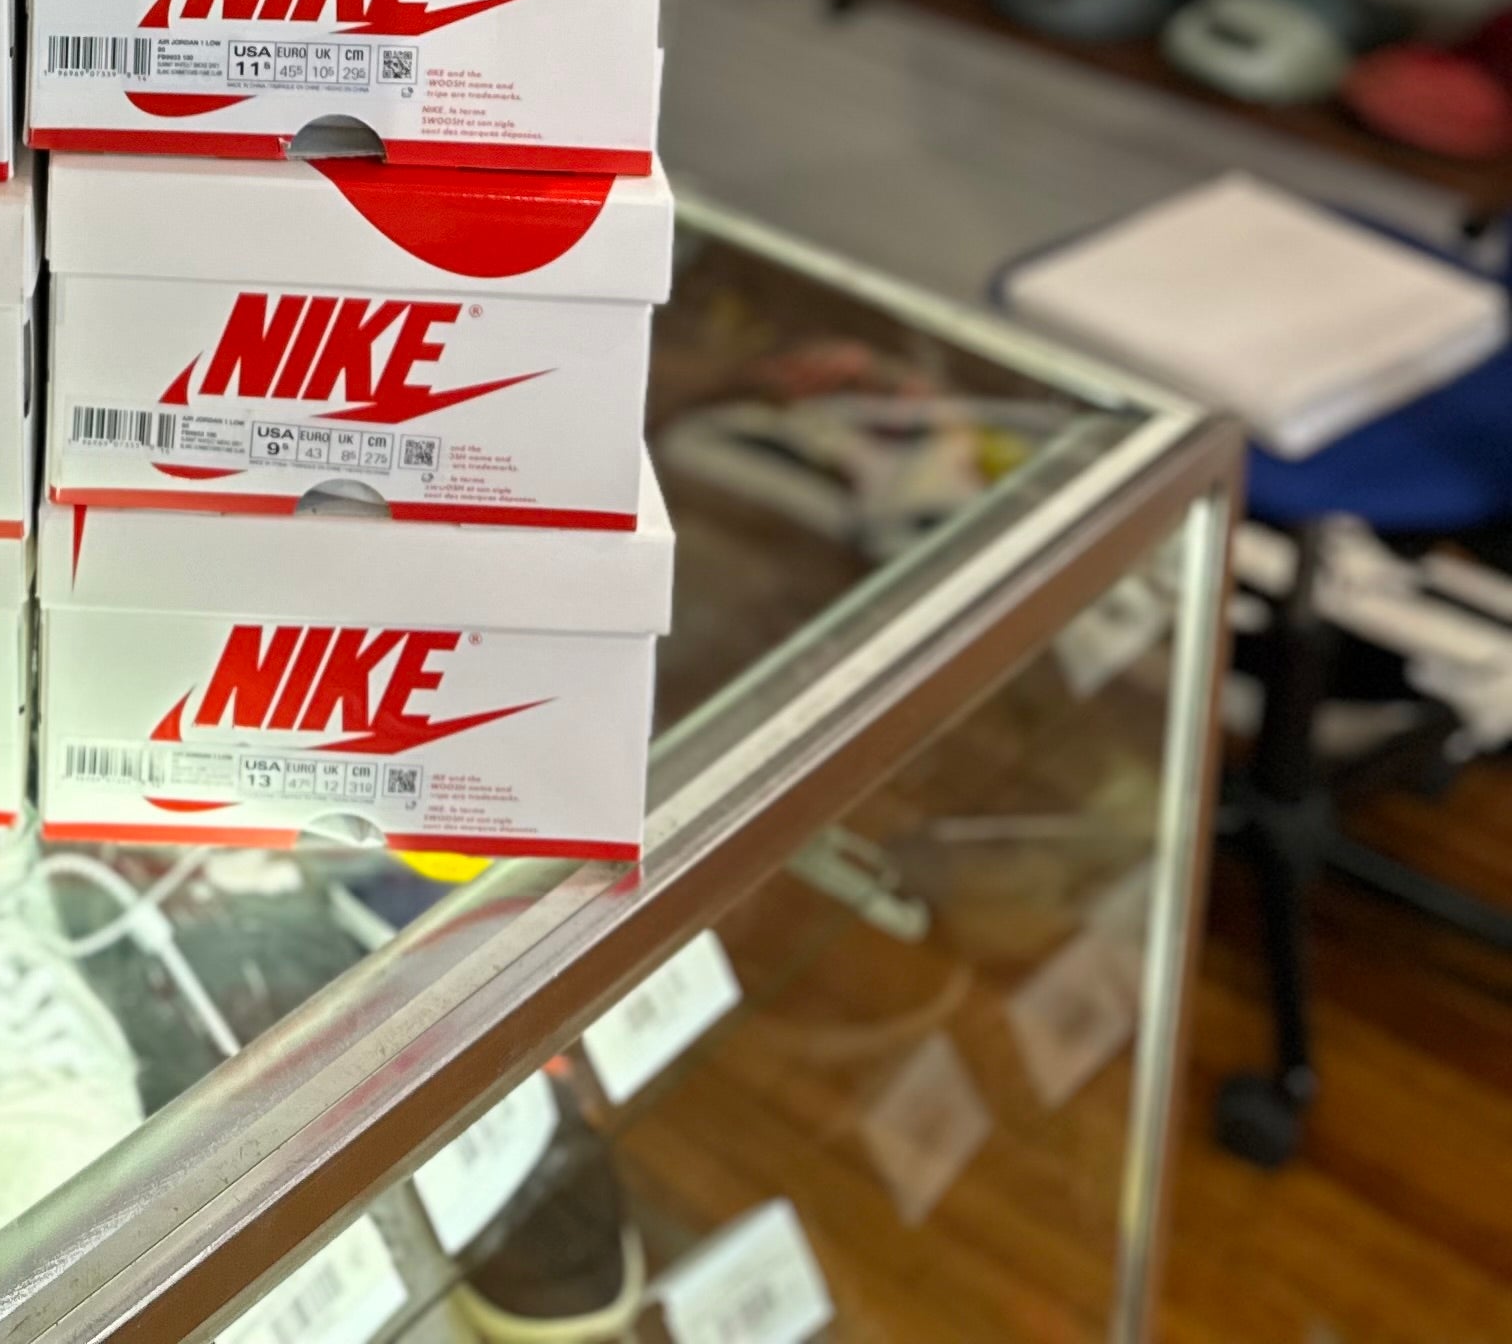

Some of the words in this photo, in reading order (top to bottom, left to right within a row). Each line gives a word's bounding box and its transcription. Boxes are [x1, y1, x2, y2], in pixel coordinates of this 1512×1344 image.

[234, 46, 271, 57] USA
[277, 47, 306, 58] EURO
[316, 48, 331, 59] UK
[346, 49, 363, 61] cm
[198, 292, 462, 403] NIKE
[258, 426, 294, 440] USA
[300, 431, 329, 442] EURO
[339, 434, 353, 444] UK
[368, 436, 386, 448] cm
[305, 448, 321, 459] 43
[193, 624, 462, 732] NIKE
[245, 761, 280, 772] USA
[287, 764, 315, 773] EURO
[323, 765, 338, 775] UK
[353, 766, 370, 777] cm
[248, 775, 271, 787] 13
